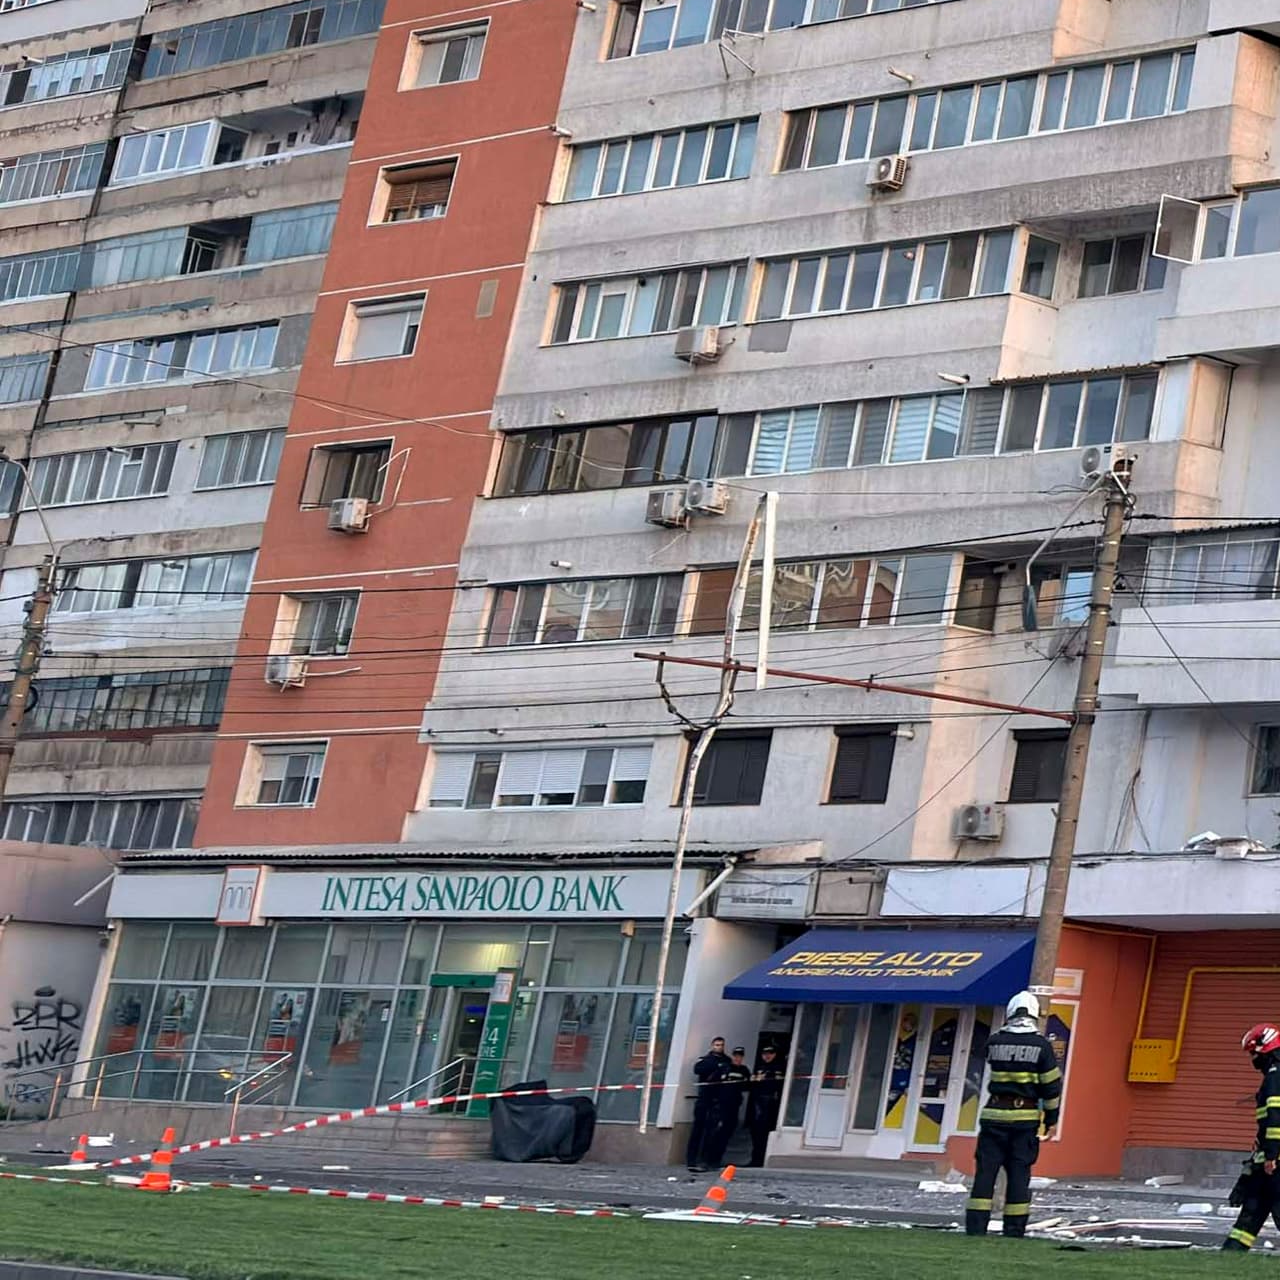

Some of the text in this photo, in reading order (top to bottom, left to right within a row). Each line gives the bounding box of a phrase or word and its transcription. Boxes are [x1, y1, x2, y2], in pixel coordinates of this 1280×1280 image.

[320, 875, 630, 911] INTESA SANPAOLO BANK
[783, 952, 983, 966] PIESE AUTO
[768, 968, 960, 976] ANDREI AUTO TECHNIK
